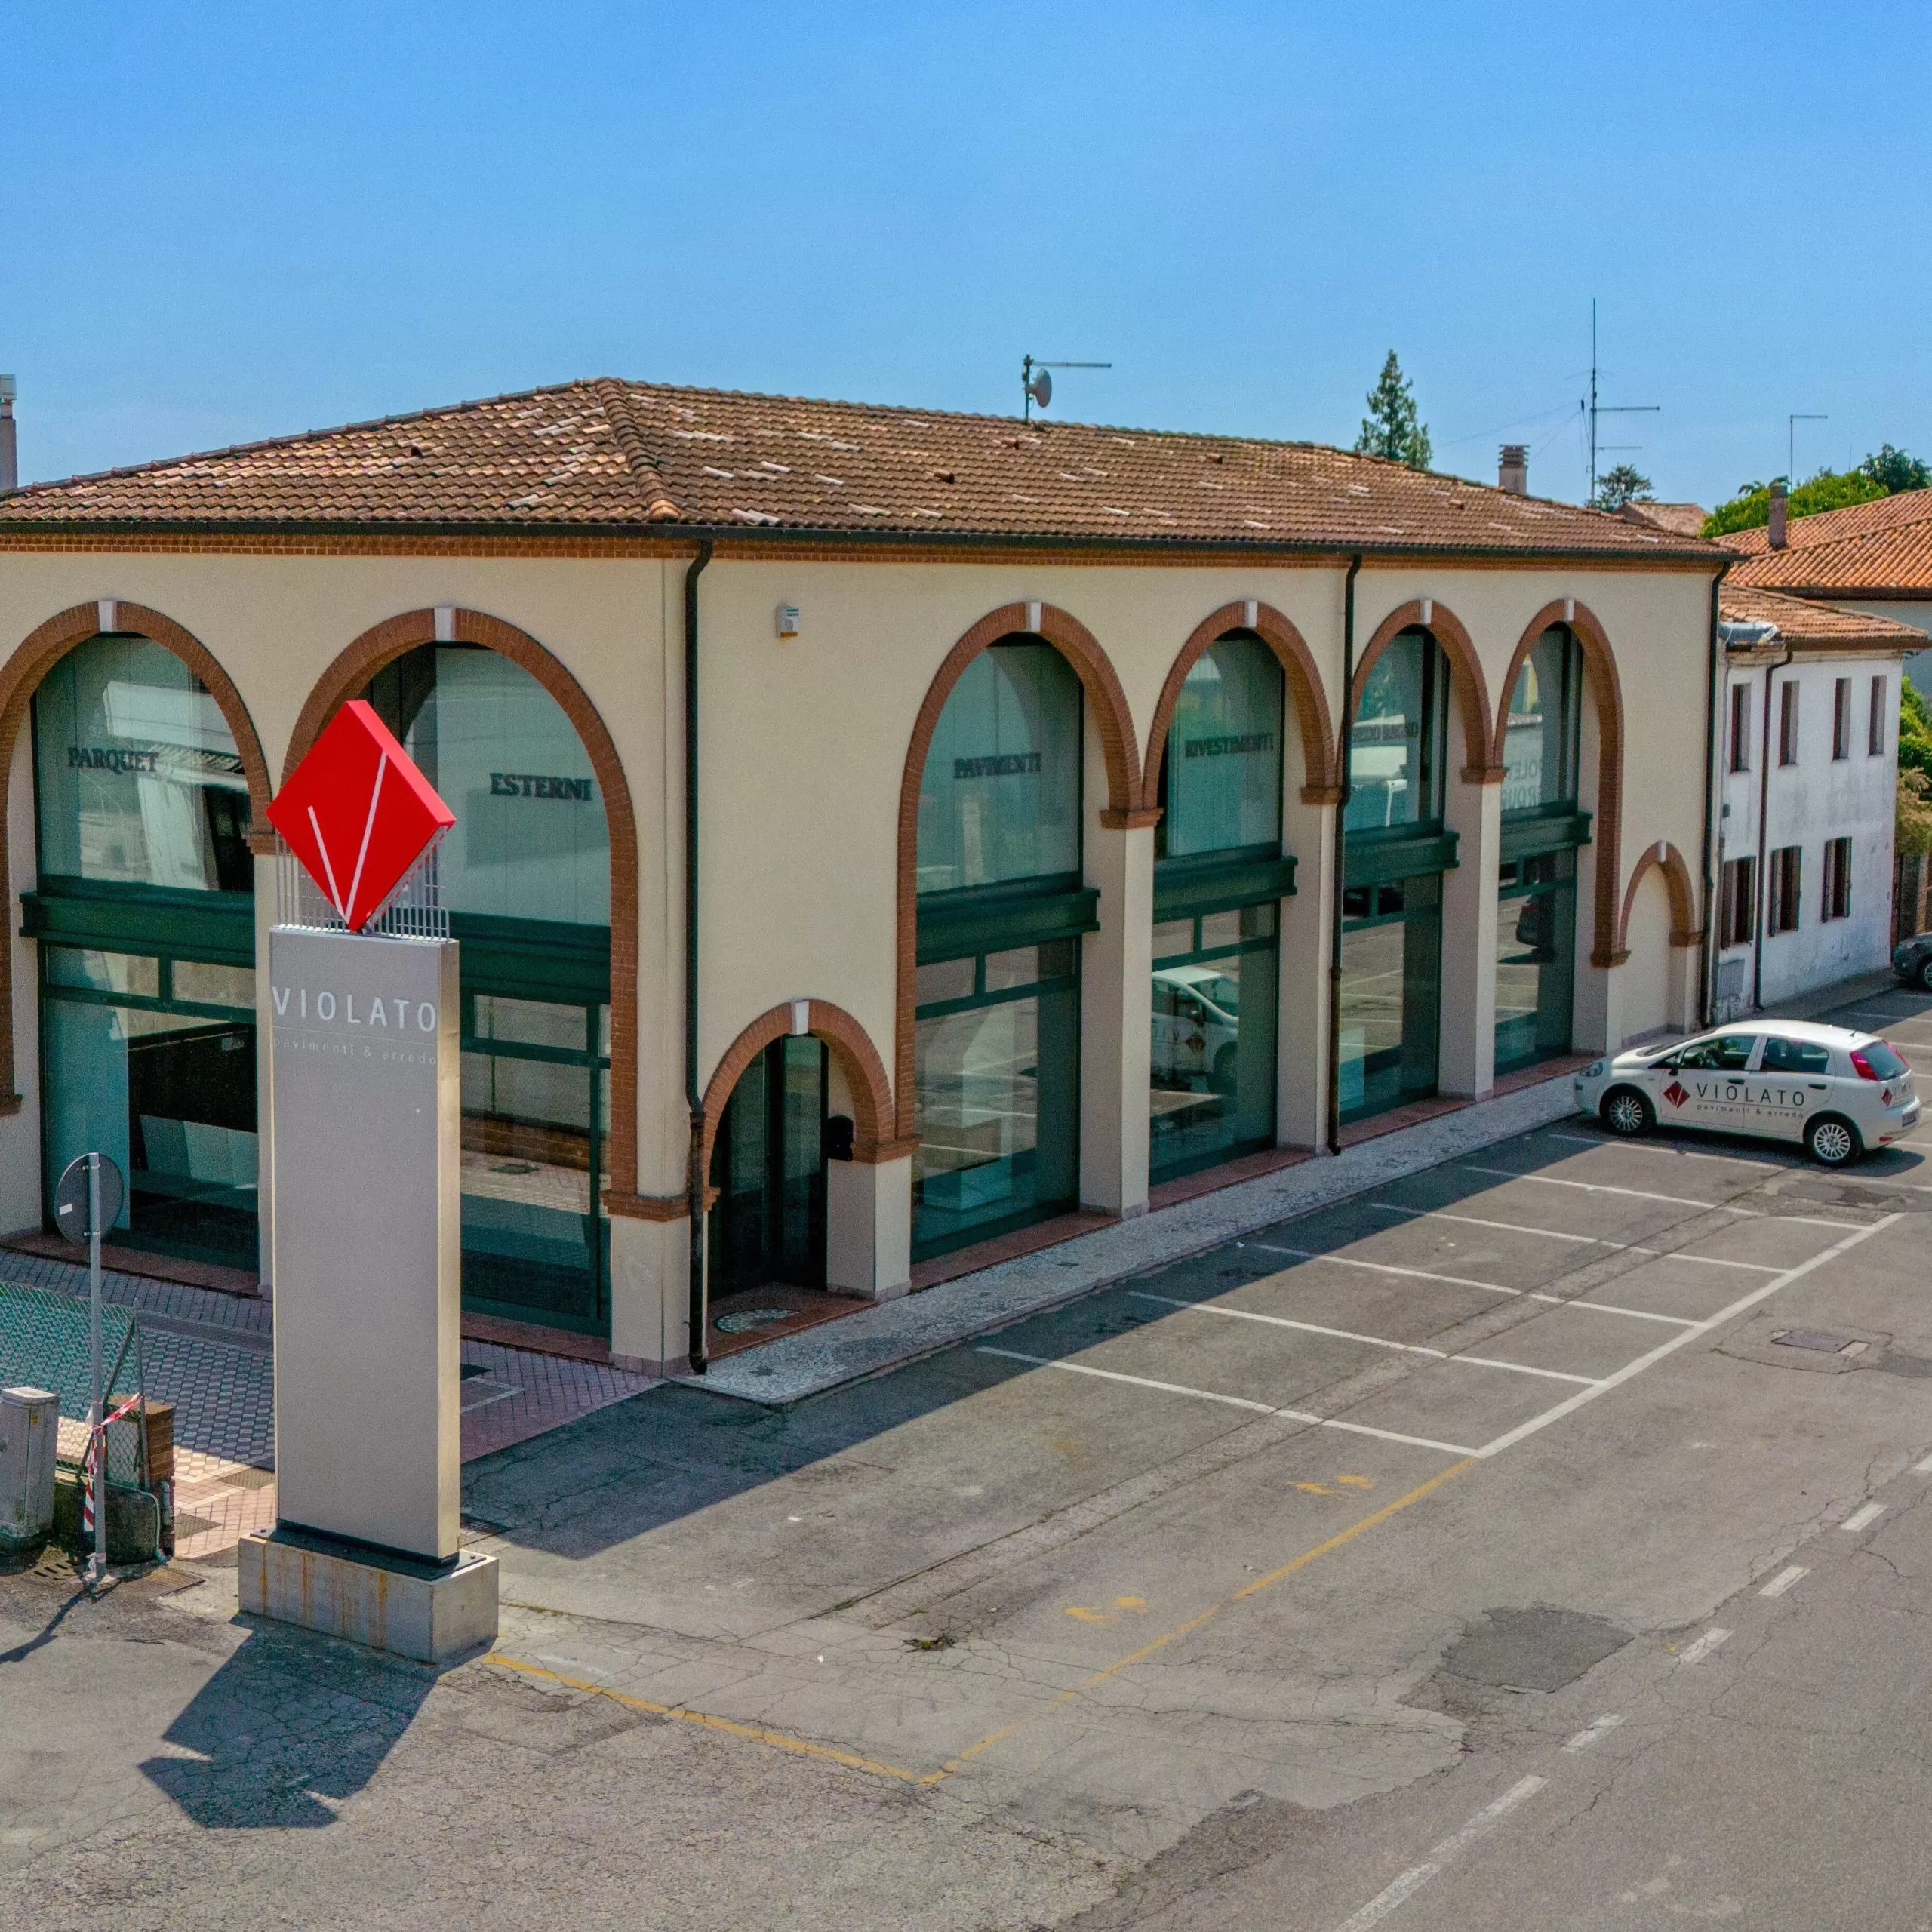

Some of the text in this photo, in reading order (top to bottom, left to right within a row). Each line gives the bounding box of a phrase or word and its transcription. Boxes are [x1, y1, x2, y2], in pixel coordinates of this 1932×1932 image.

[1185, 733, 1274, 758] RIVESTIMENTI
[67, 747, 159, 774] PARQUET
[954, 753, 1041, 779] PAVIMENTI
[490, 772, 593, 801] ESTERNI
[272, 986, 437, 1033] VIOLATO
[274, 1036, 437, 1066] pavimenti & arredo
[1697, 1082, 1804, 1106] VIOLATO
[1697, 1103, 1749, 1115] pavimenti
[1767, 1110, 1804, 1119] arredo
